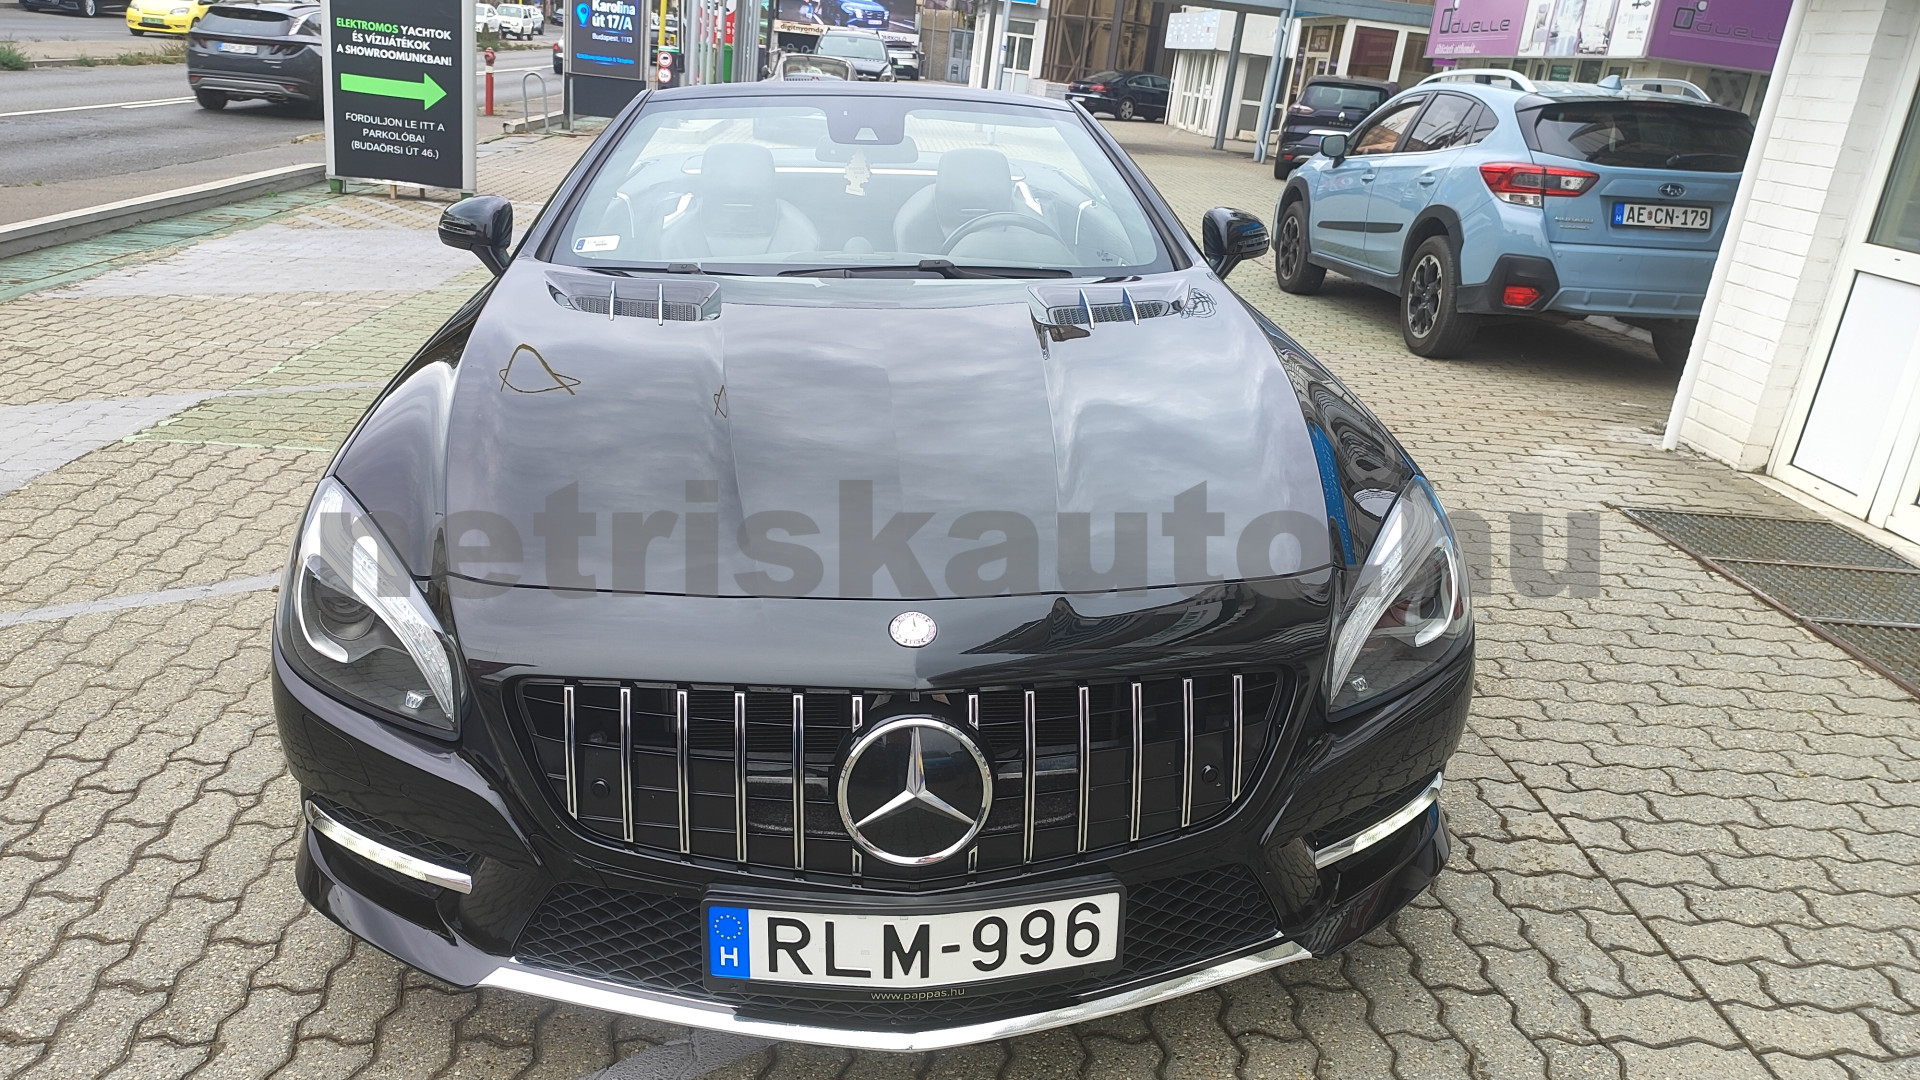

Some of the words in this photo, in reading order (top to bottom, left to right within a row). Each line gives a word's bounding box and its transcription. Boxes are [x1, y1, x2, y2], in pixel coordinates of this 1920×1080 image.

[591, 0, 636, 16] Karolina
[336, 17, 399, 34] ELEKTROMOS
[400, 25, 452, 40] YACHTOK
[591, 13, 605, 28] út
[606, 15, 633, 31] 17/A
[780, 23, 824, 34] digitnyomda
[352, 30, 363, 42] ÉS
[364, 33, 431, 51] VÍZIJÁTÉKOK
[336, 43, 344, 53] A
[345, 45, 453, 66] SHOWROOMUNKBAN!
[345, 112, 403, 128] FORDULJON
[404, 120, 418, 130] LE
[419, 121, 436, 131] ITT
[437, 123, 446, 132] A
[362, 128, 426, 144] PARKOLÓBA!
[351, 140, 404, 155] (BUDAÖRSI
[405, 145, 420, 156] ÚT
[421, 149, 440, 160] 46.)
[1625, 206, 1648, 224] AE
[1653, 207, 1709, 227] CN-179
[719, 945, 739, 968] H
[767, 901, 1102, 980] RLM-996
[870, 987, 966, 1001] www.pappas.hu
